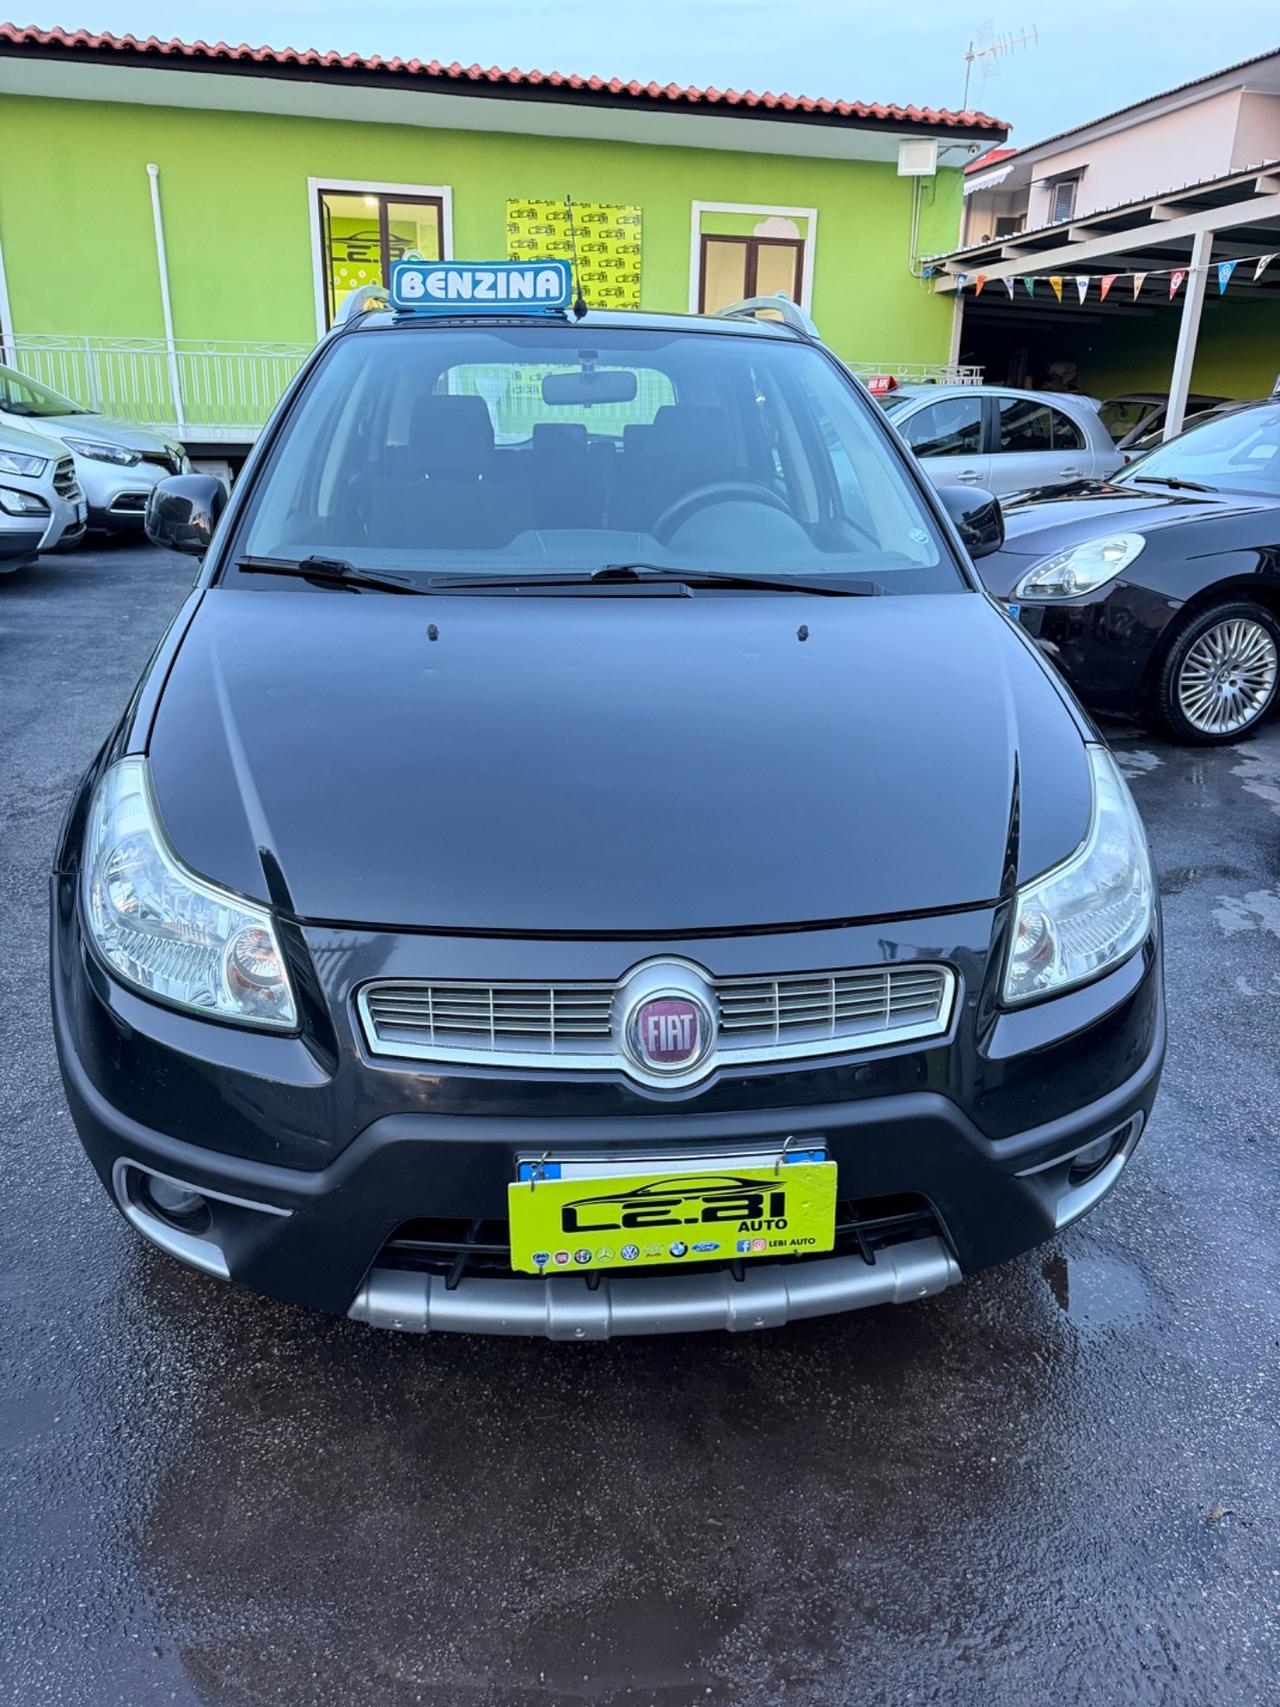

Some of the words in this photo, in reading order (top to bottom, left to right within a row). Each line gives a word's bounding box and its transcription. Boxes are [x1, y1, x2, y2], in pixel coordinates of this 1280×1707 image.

[401, 271, 559, 299] BENZINA
[648, 1014, 693, 1052] FIAT
[738, 1218, 788, 1233] AUTO
[769, 1239, 787, 1248] LEBI
[790, 1237, 816, 1247] AUTO
